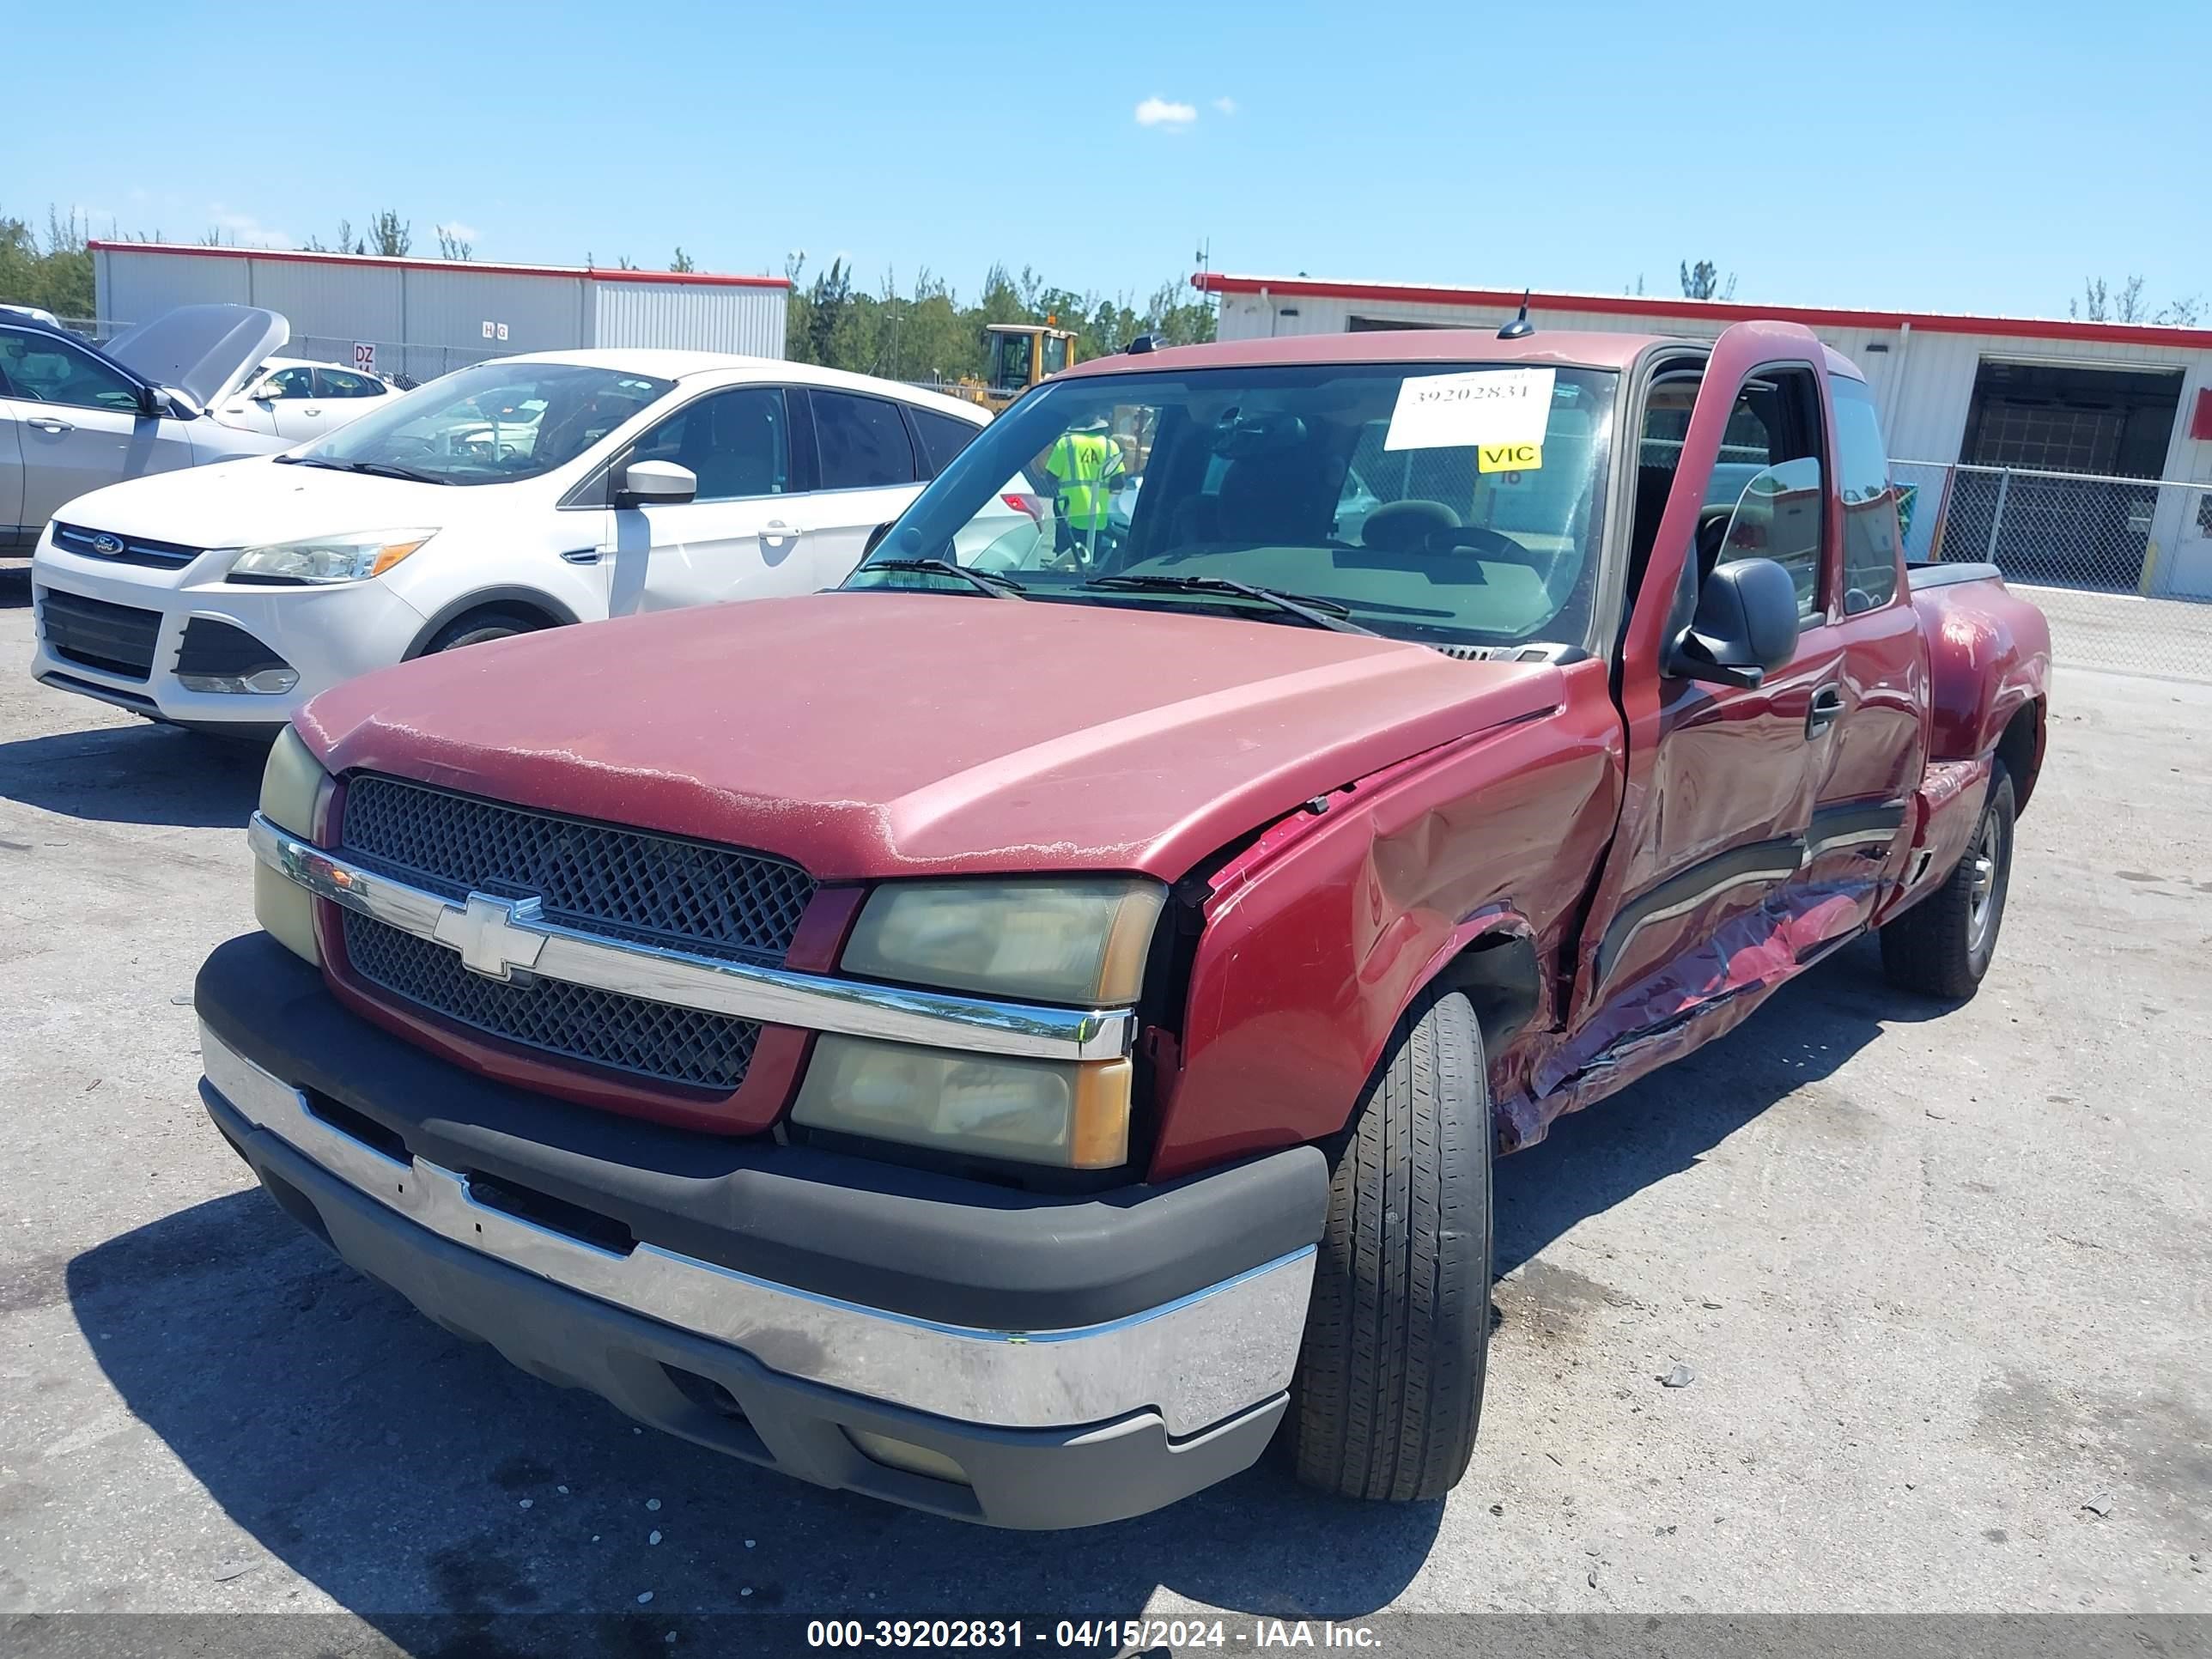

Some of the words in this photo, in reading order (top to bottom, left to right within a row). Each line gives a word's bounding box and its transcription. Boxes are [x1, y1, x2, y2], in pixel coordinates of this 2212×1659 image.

[484, 325, 493, 337] H
[498, 326, 506, 337] G
[356, 345, 374, 363] DZ
[1411, 385, 1528, 405] 39202831
[1485, 447, 1534, 464] VIC
[96, 536, 114, 551] Ford
